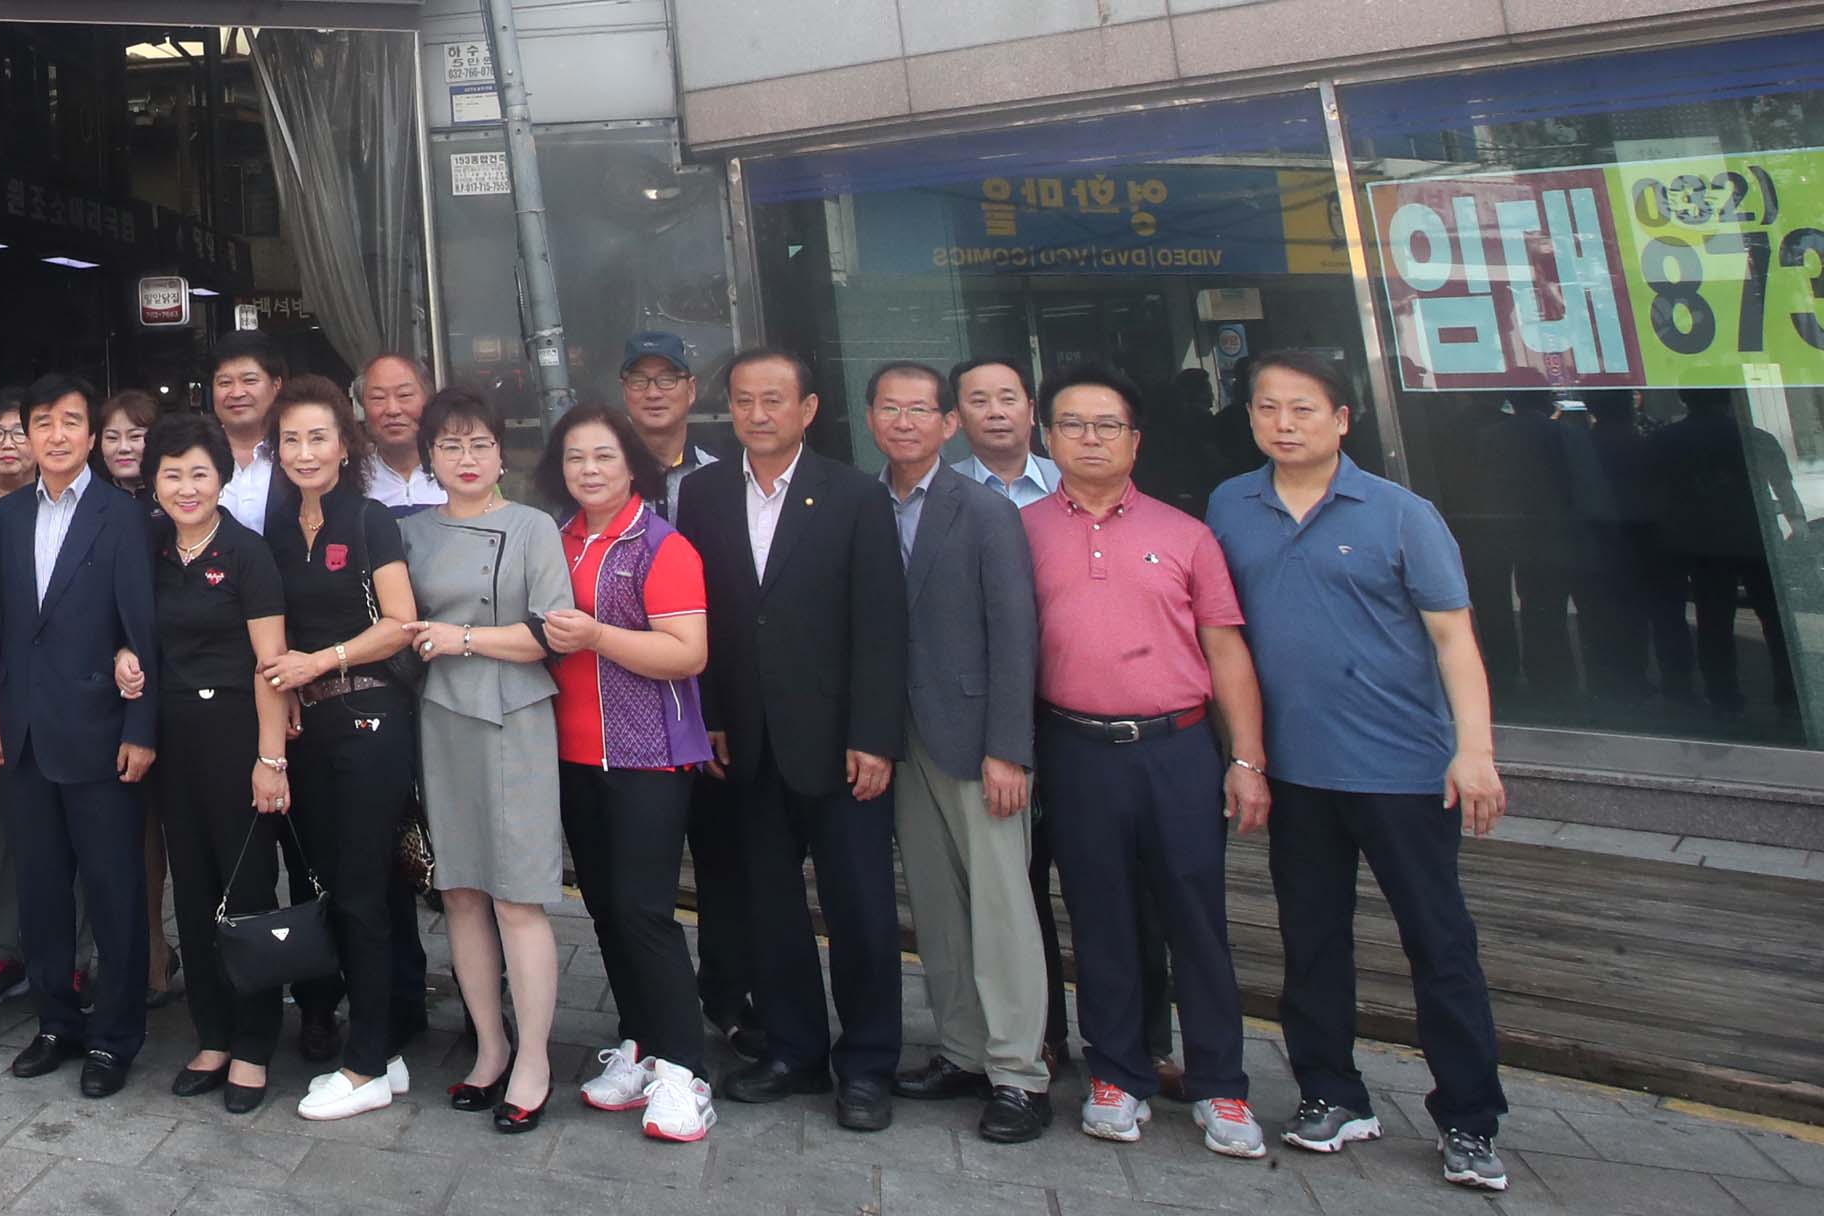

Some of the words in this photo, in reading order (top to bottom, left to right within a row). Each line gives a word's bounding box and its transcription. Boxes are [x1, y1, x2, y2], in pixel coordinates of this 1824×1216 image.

[1631, 165, 1779, 229] 032)
[1389, 187, 1631, 375] 임대
[1640, 228, 1824, 356] 873
